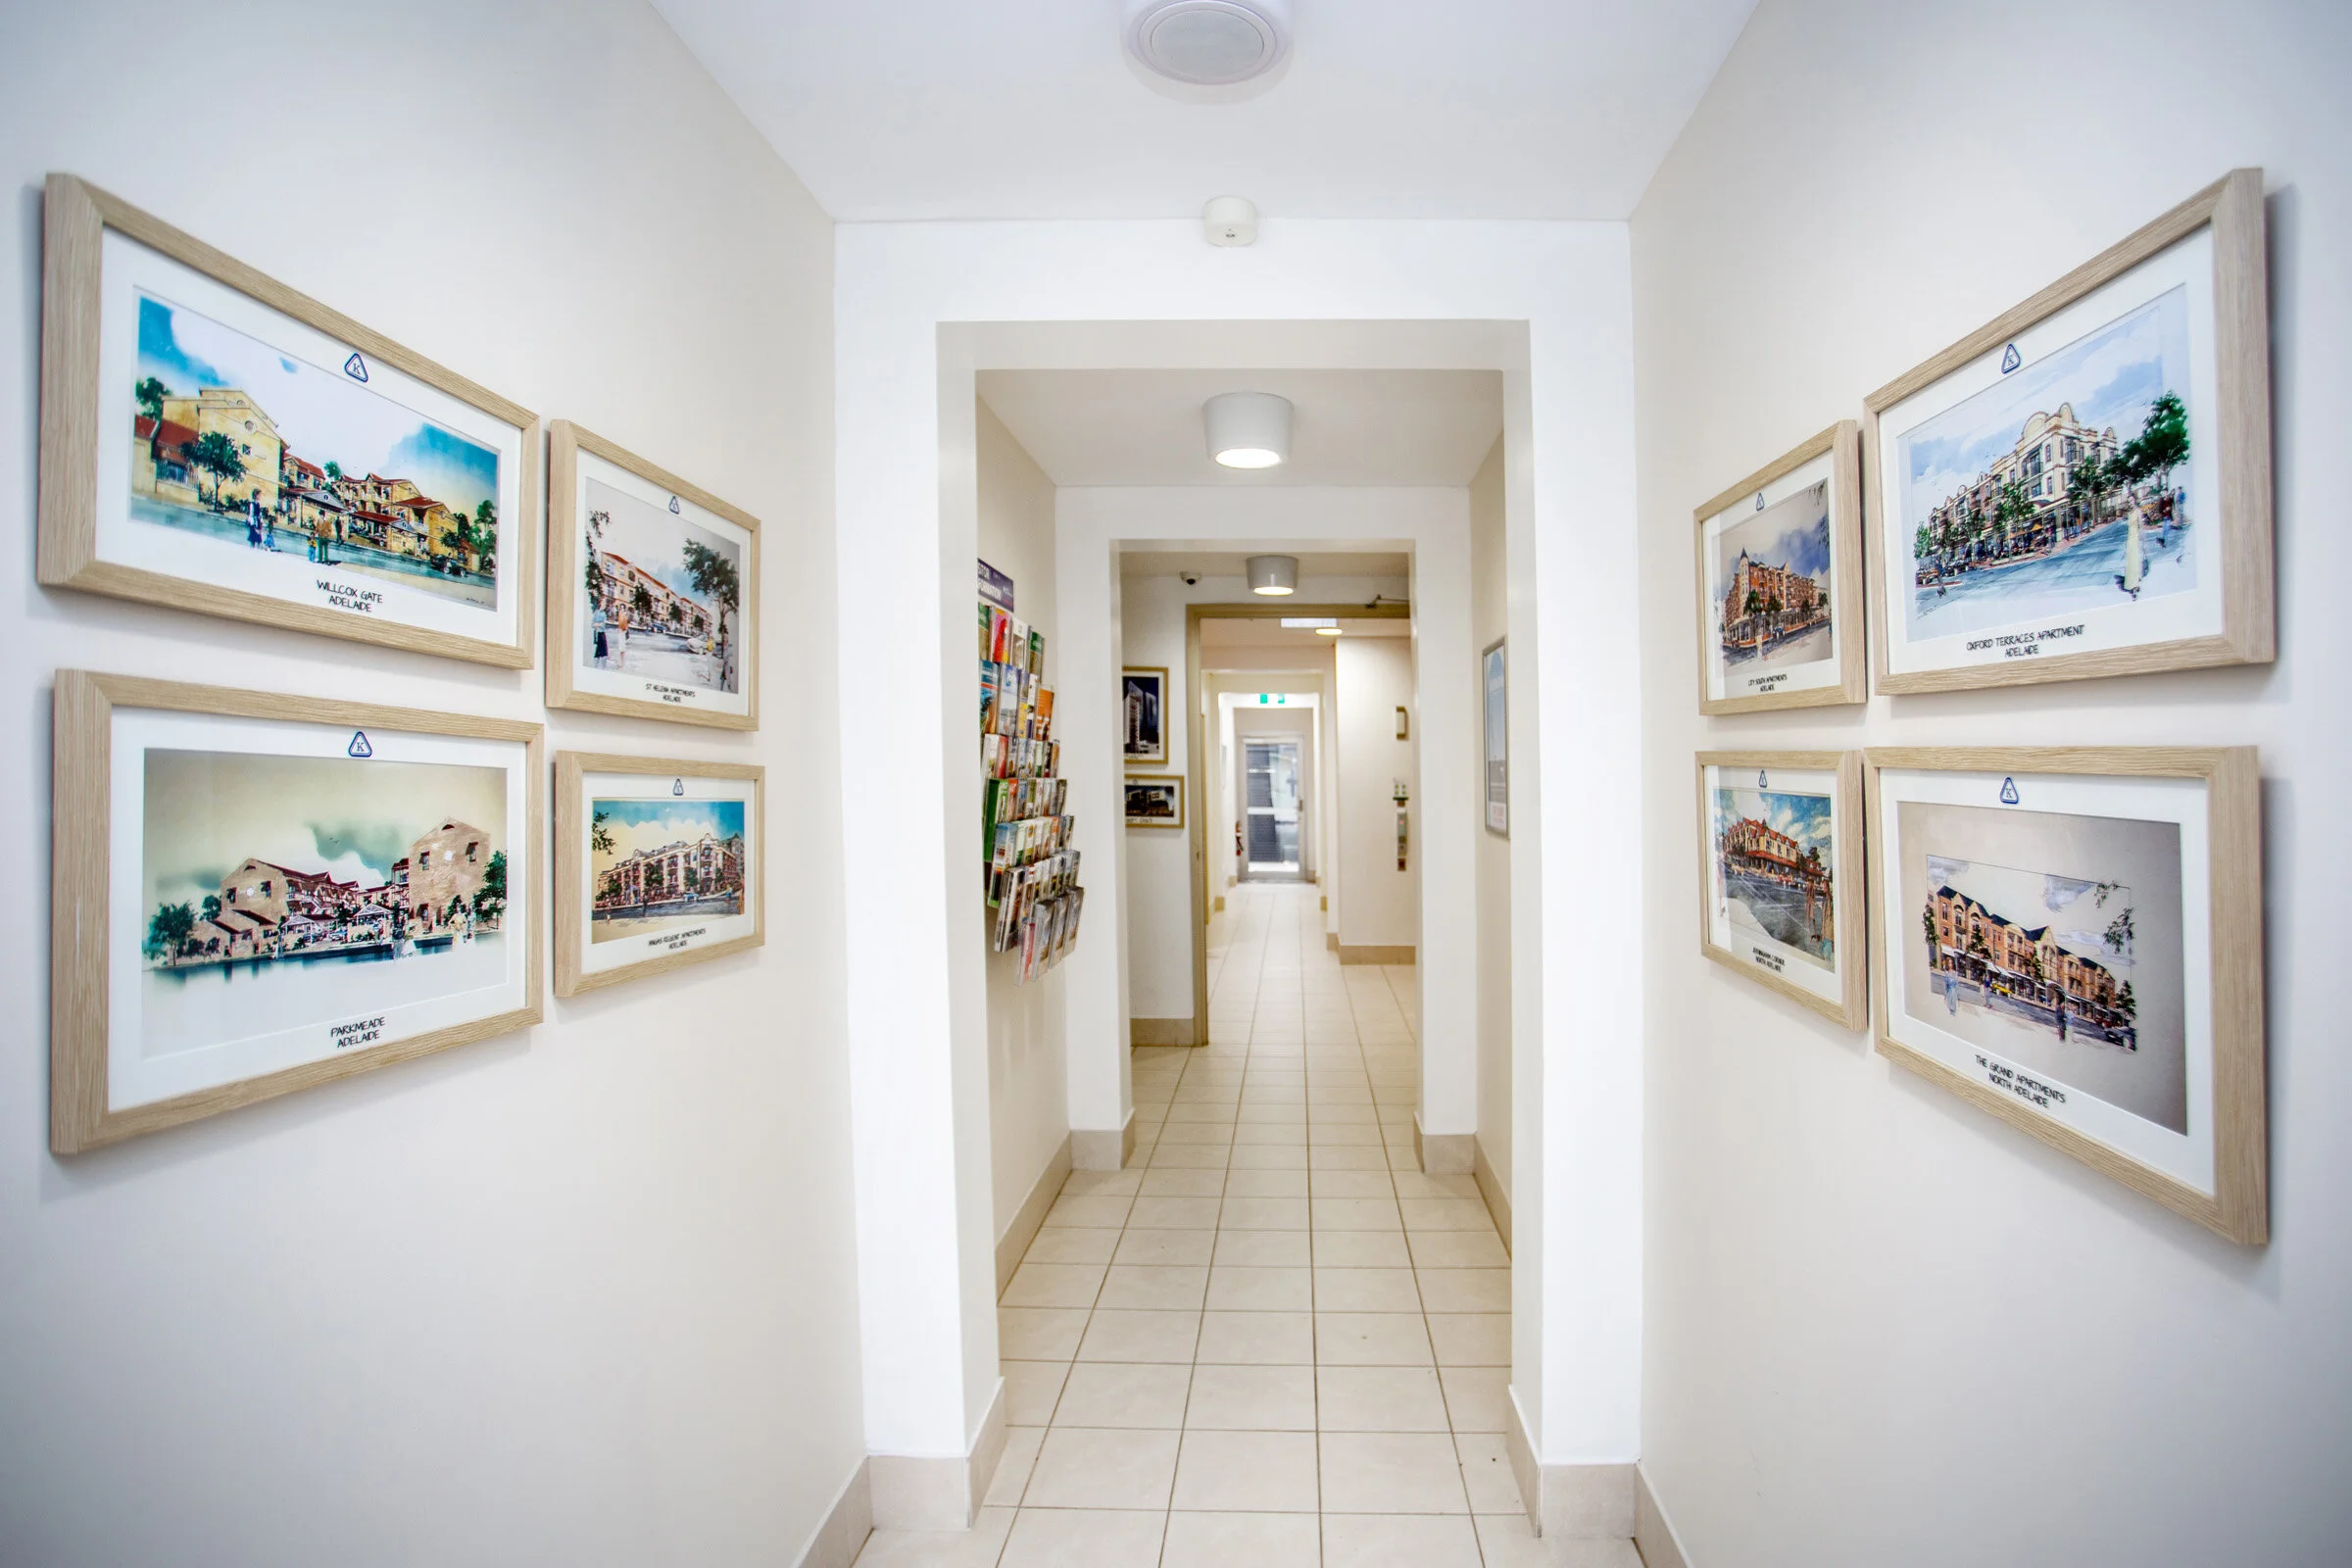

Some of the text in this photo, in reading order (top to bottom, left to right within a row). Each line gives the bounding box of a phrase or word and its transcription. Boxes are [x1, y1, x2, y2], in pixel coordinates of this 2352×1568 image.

[317, 579, 383, 604] WILLCOX GATE
[329, 595, 372, 612] ADELAIDE
[1966, 624, 2084, 652] OXFORD TERRACES APARTMENT
[2004, 644, 2039, 658] ADELAIDE
[330, 1017, 386, 1038] PARKMEADE
[337, 1030, 380, 1048] ADELAIDE
[1975, 1054, 2066, 1103] THE GRAND APARTMENTS
[1988, 1072, 2049, 1108] NORTH ADELAIDE
